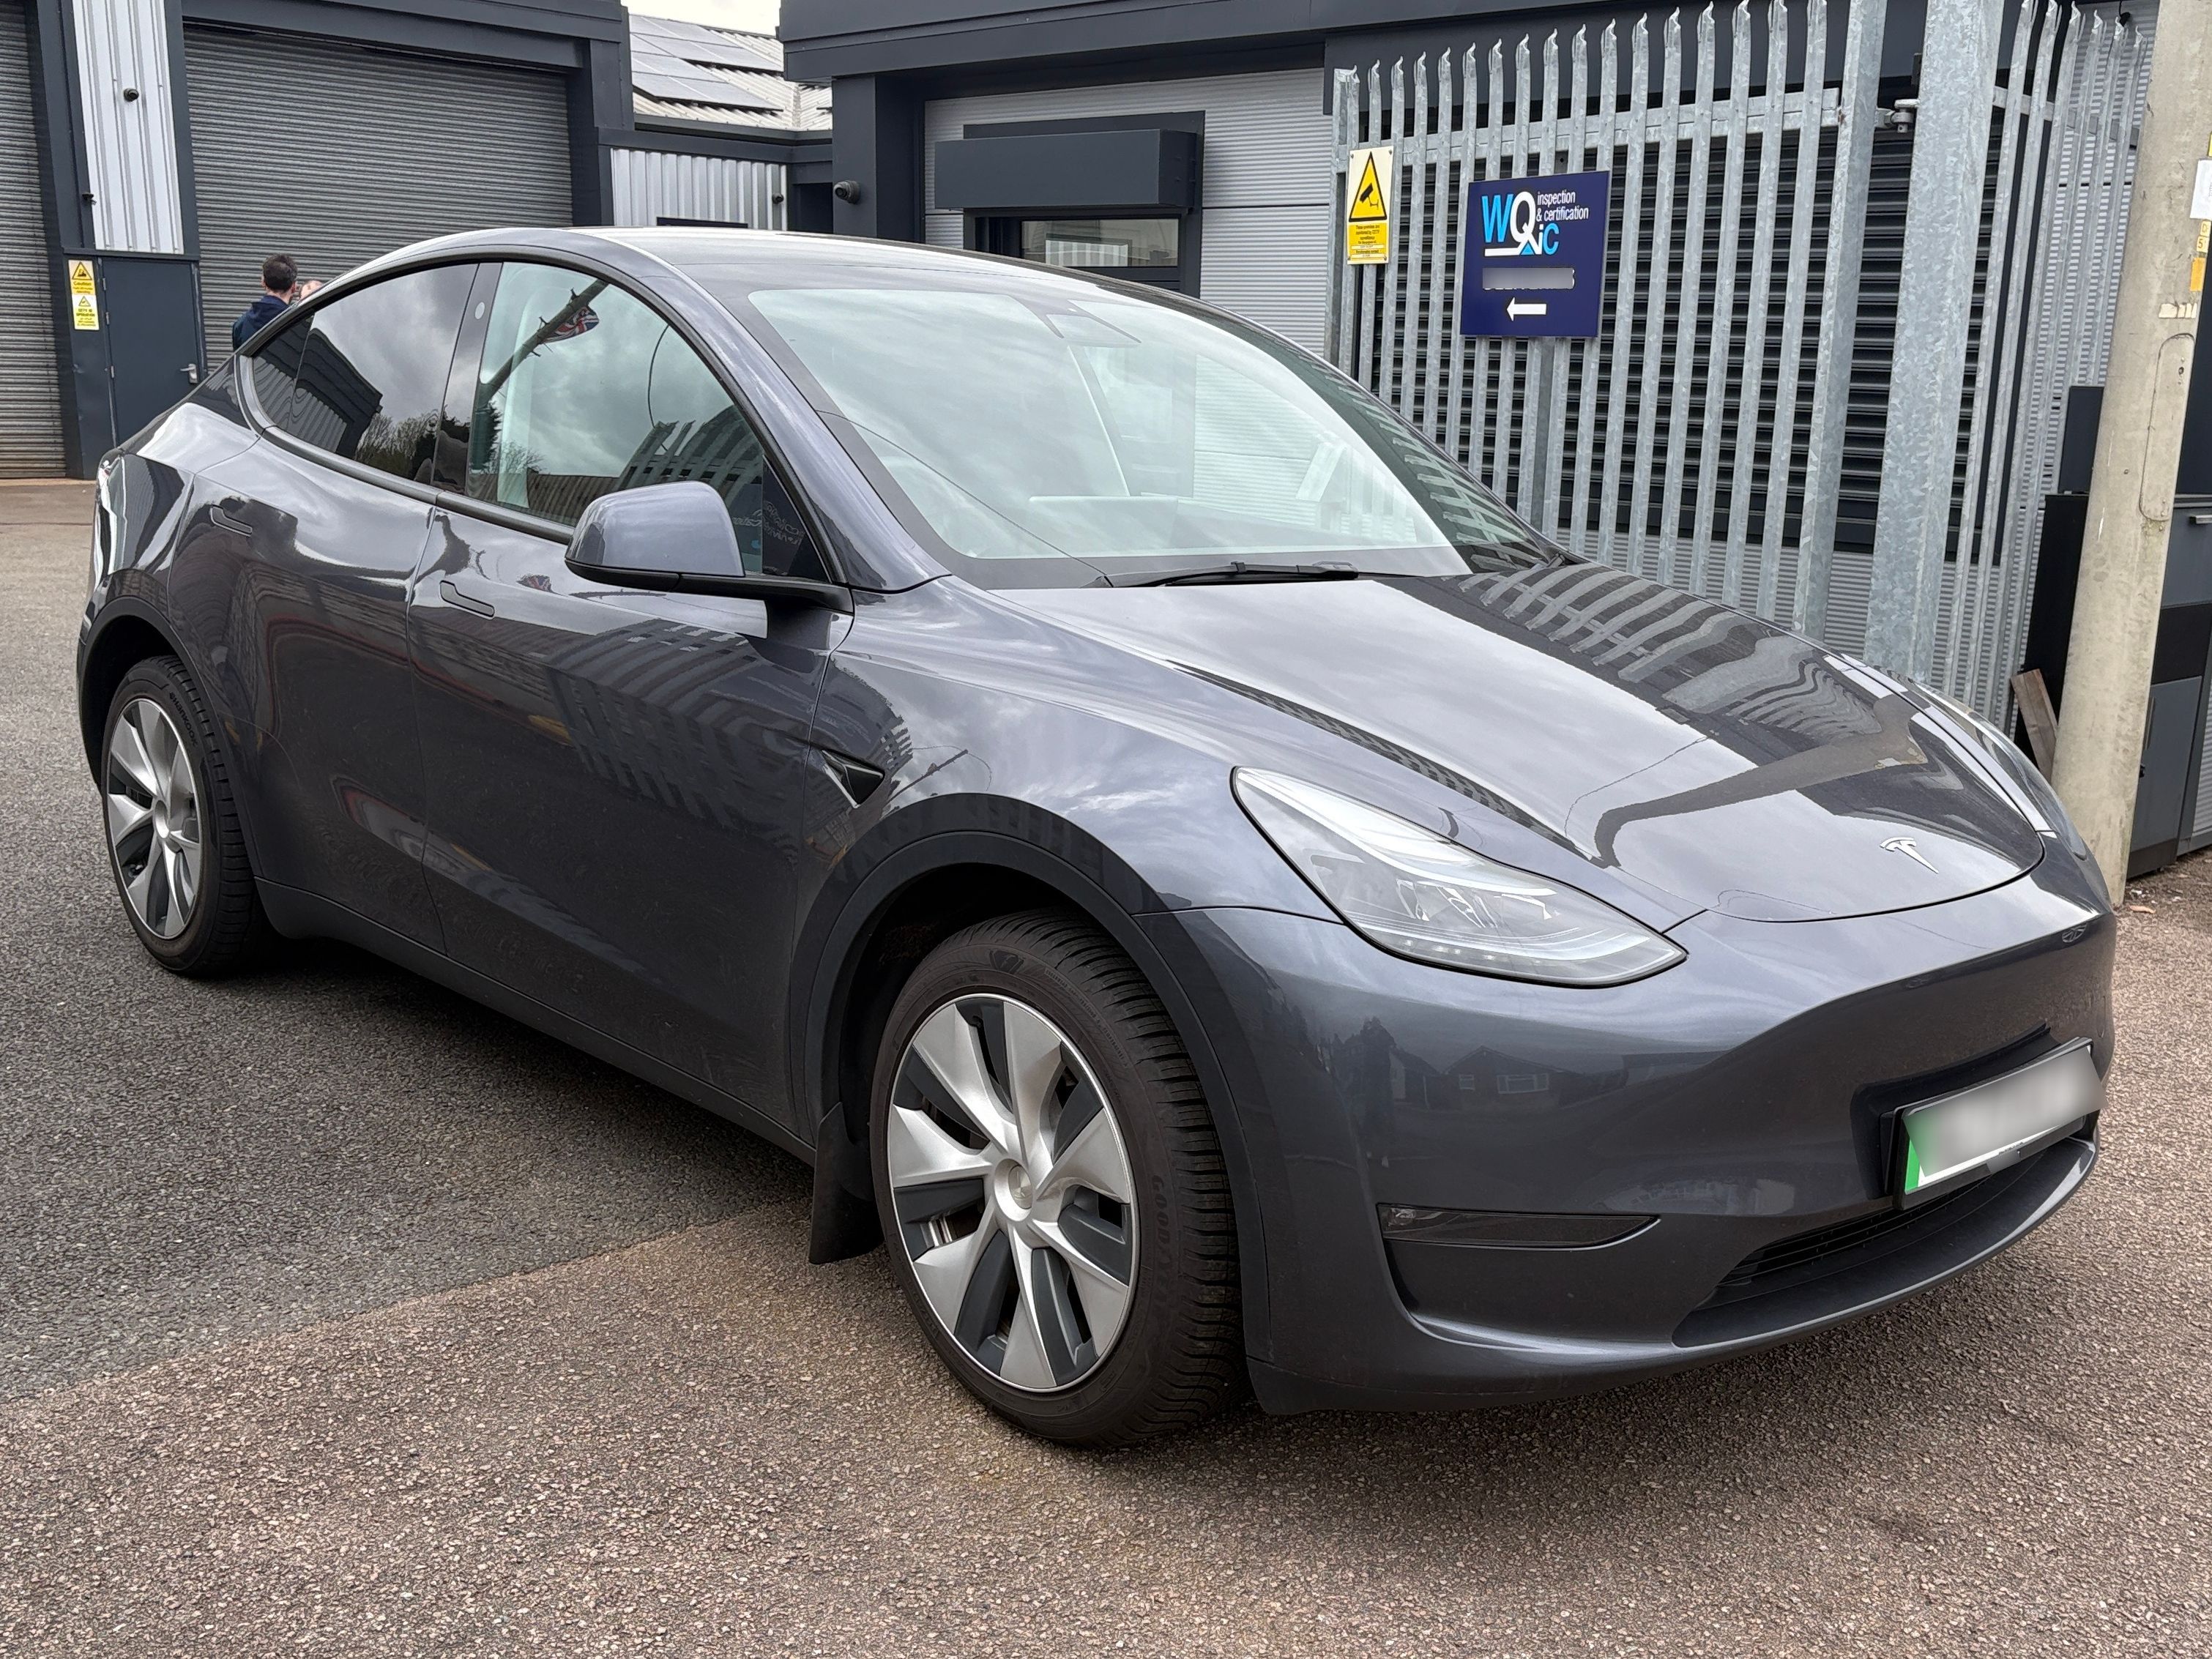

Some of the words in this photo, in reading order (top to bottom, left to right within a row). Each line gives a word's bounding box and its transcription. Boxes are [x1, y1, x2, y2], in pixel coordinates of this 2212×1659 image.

[1537, 189, 1576, 208] inspection
[1535, 207, 1542, 222] &
[1543, 204, 1589, 222] certification
